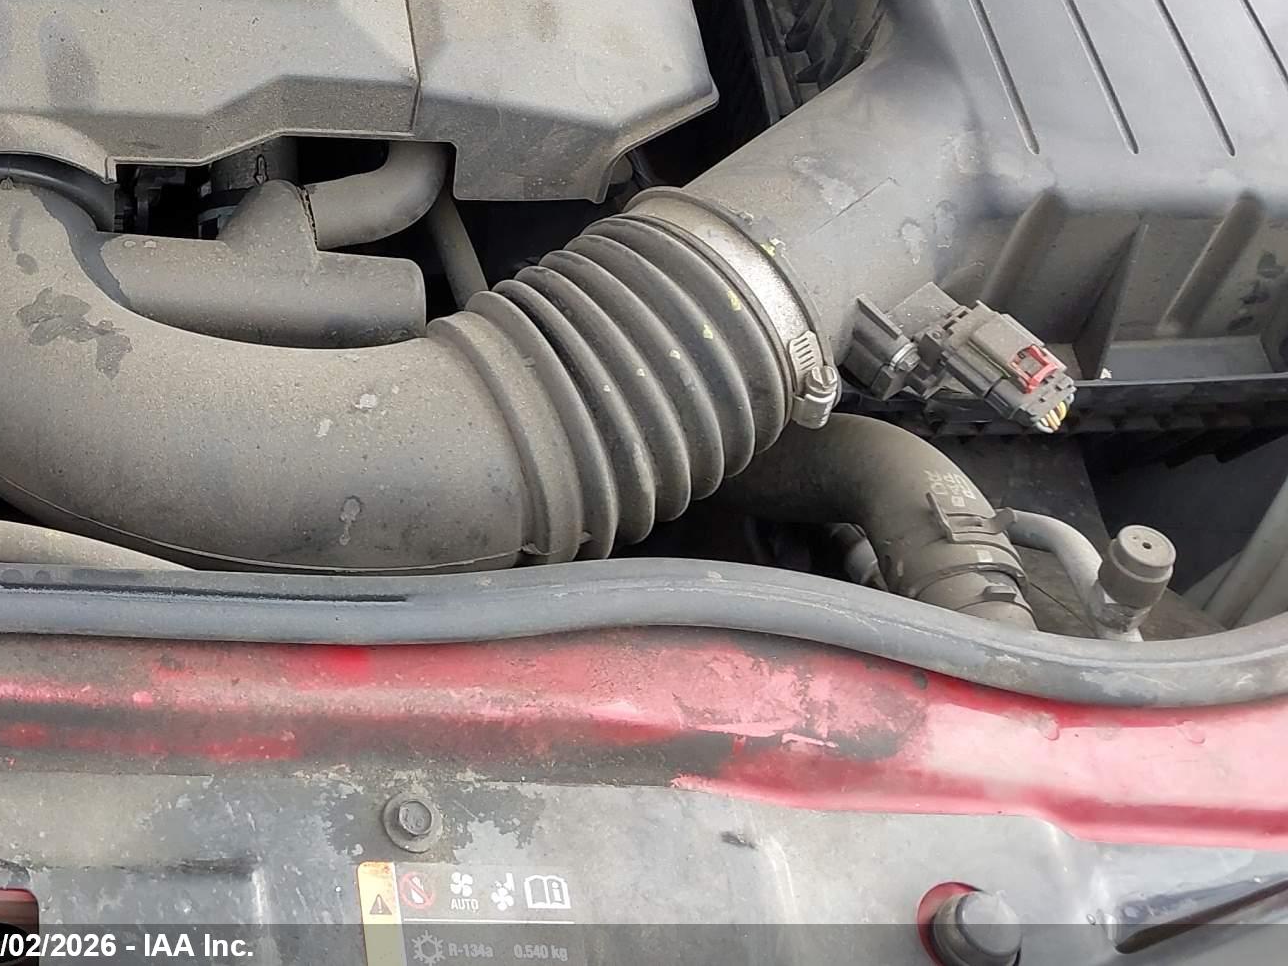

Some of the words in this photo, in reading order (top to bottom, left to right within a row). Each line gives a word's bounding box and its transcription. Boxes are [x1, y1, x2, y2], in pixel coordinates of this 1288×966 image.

[450, 898, 479, 911] AUTO
[448, 942, 494, 958] R-134a
[513, 944, 549, 959] 0.540
[551, 944, 569, 962] kg
